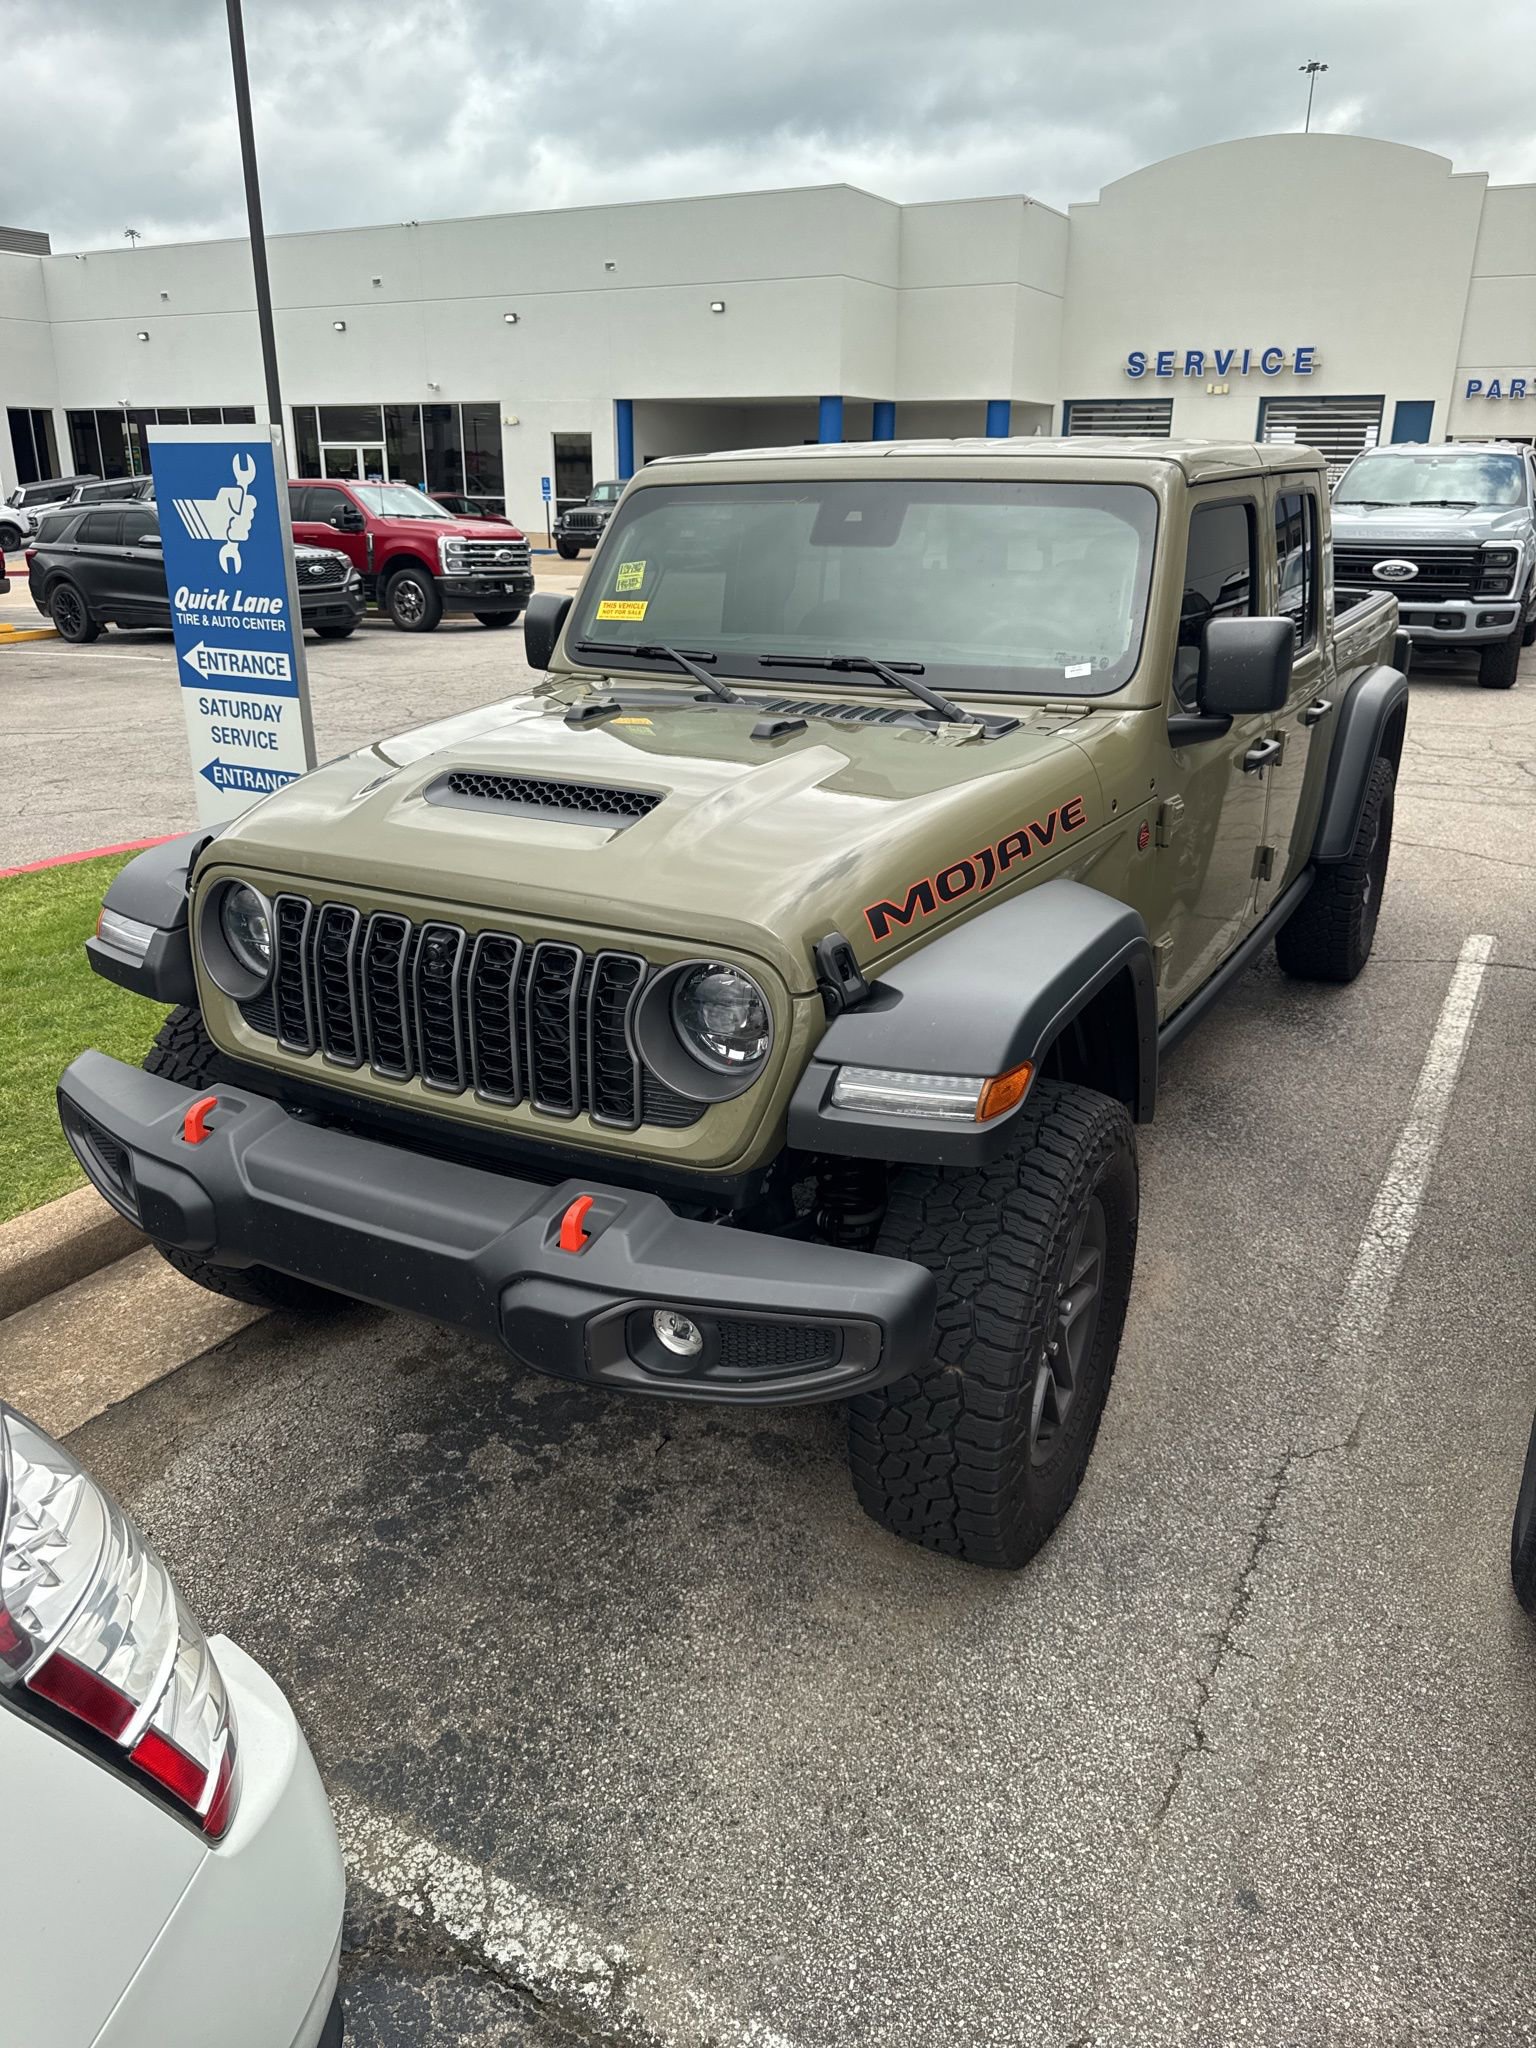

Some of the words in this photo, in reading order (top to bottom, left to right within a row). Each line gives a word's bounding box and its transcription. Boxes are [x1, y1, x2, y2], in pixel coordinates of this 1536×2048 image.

[1126, 347, 1316, 378] SERVICE
[1465, 378, 1536, 400] PAR
[174, 586, 230, 611] Quick
[232, 590, 283, 615] Lane
[618, 602, 645, 610] VEHICLE
[176, 613, 200, 626] TIRE
[202, 614, 210, 627] &
[211, 615, 240, 629] AUTO
[242, 618, 286, 632] CENTER
[197, 651, 287, 677] ENTRANCE
[199, 697, 283, 723] SATURDAY
[211, 726, 279, 751] SERVICE
[213, 766, 298, 791] ENTRANC
[864, 795, 1087, 942] MOJAVE
